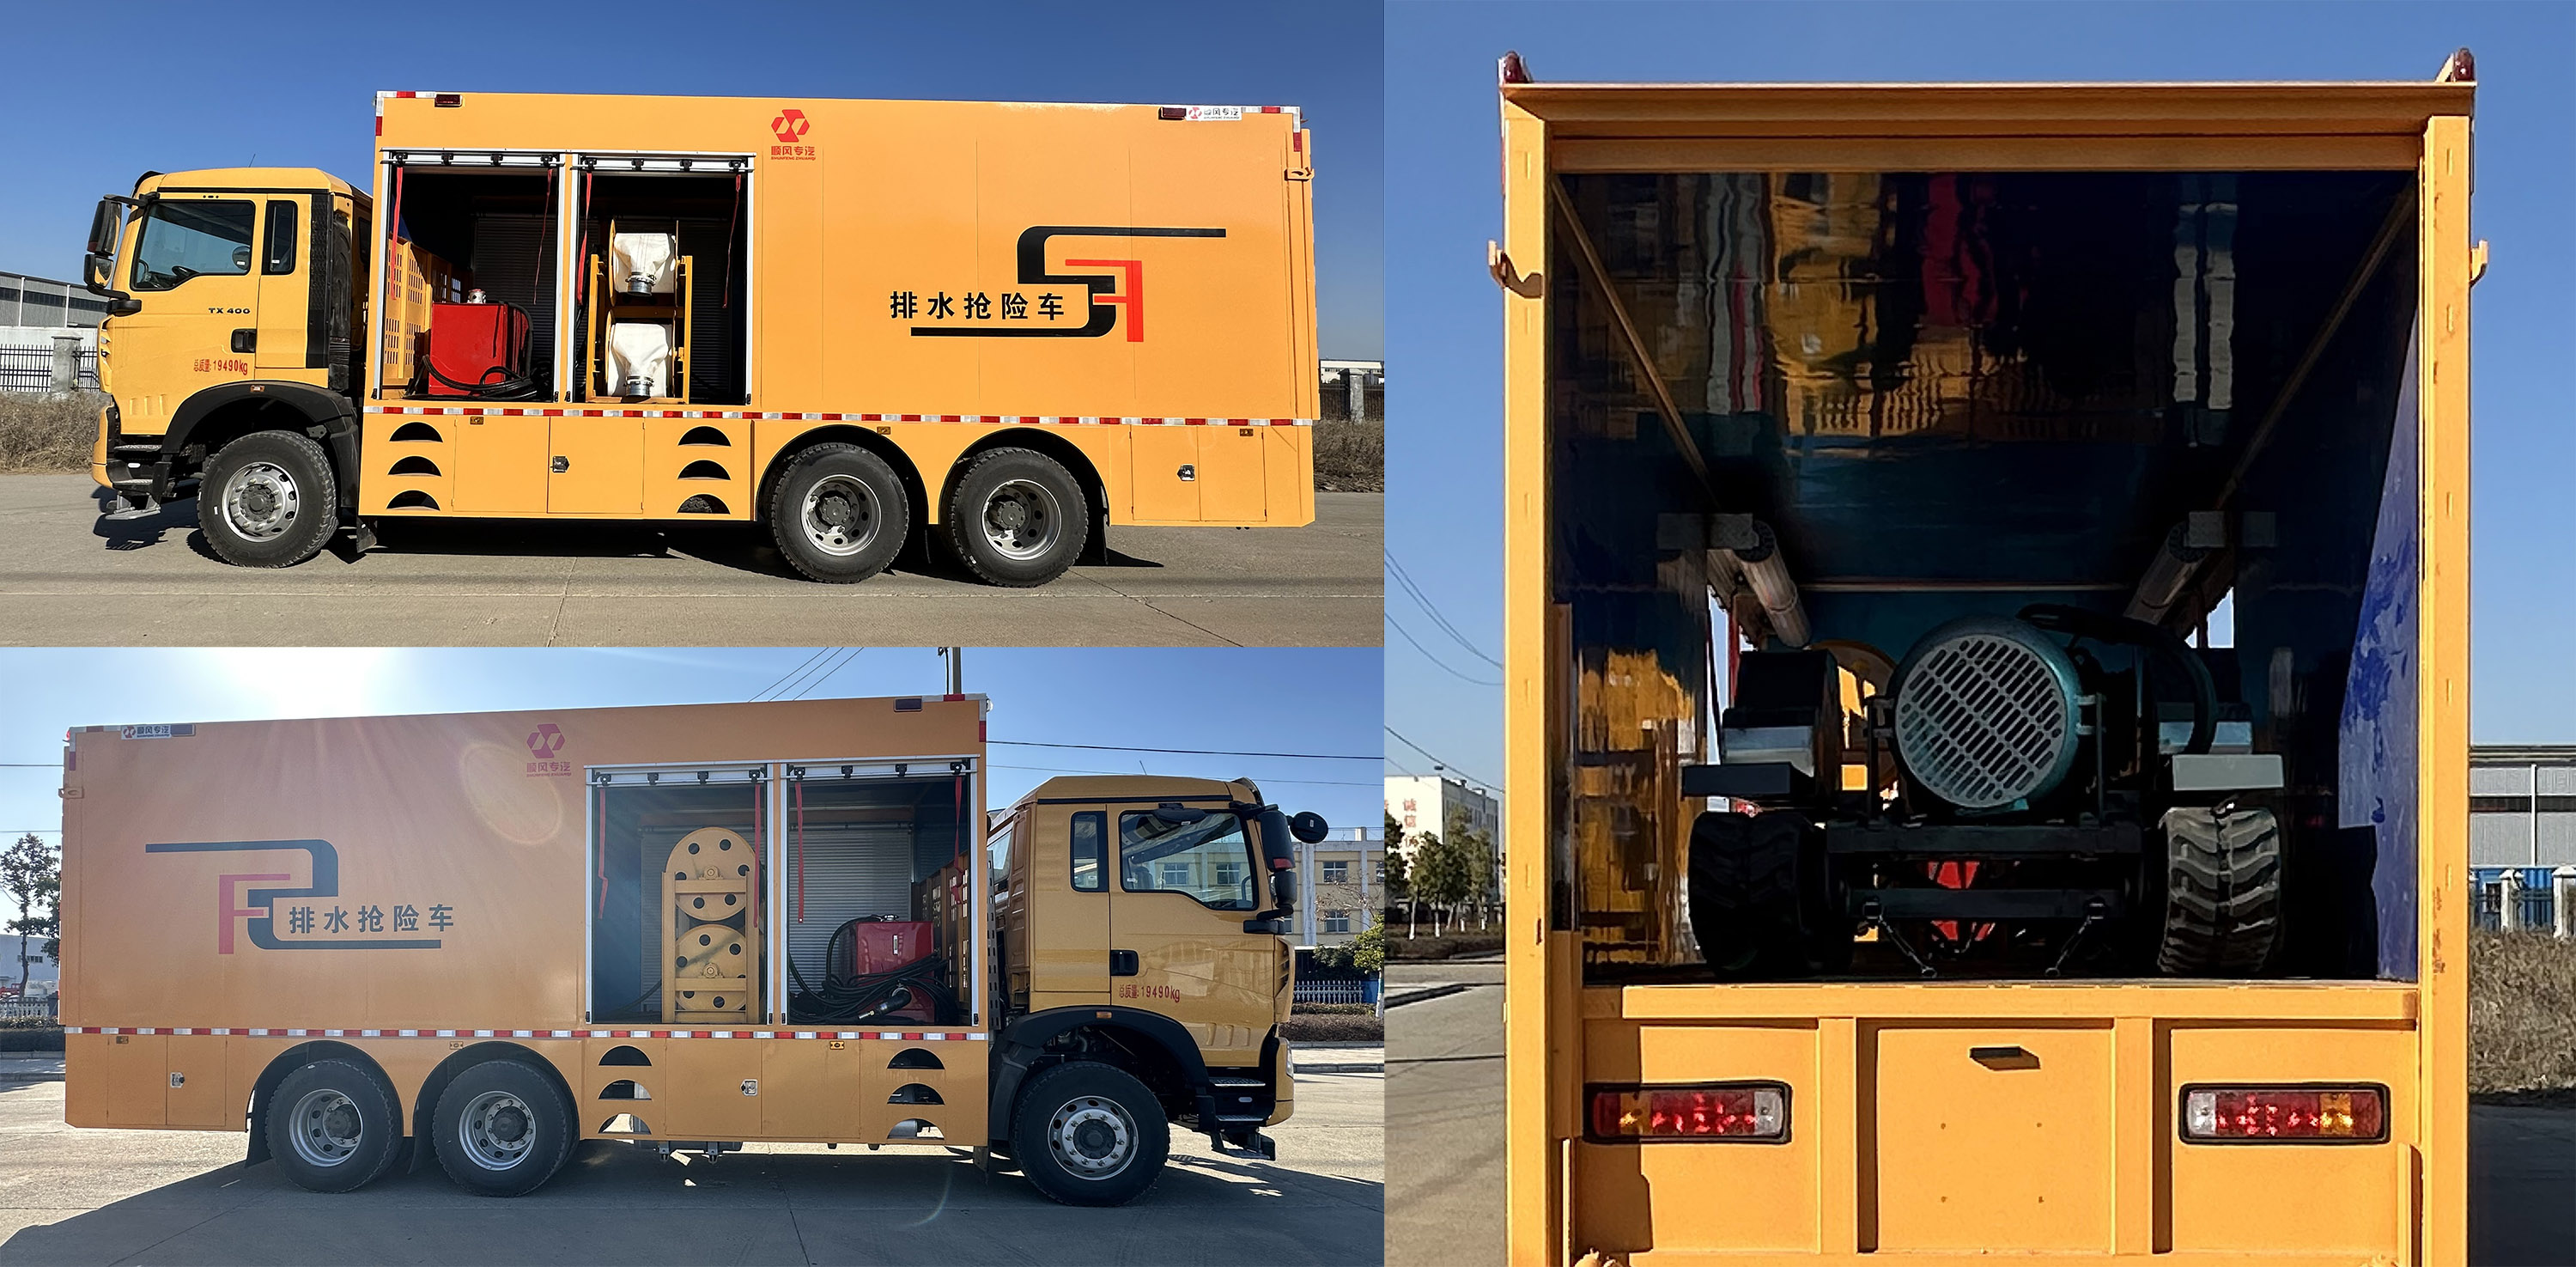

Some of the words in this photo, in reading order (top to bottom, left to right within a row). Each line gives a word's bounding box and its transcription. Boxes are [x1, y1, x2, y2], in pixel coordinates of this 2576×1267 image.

[890, 290, 1065, 320] 排水抢险车
[289, 904, 454, 934] 排水抢险车
